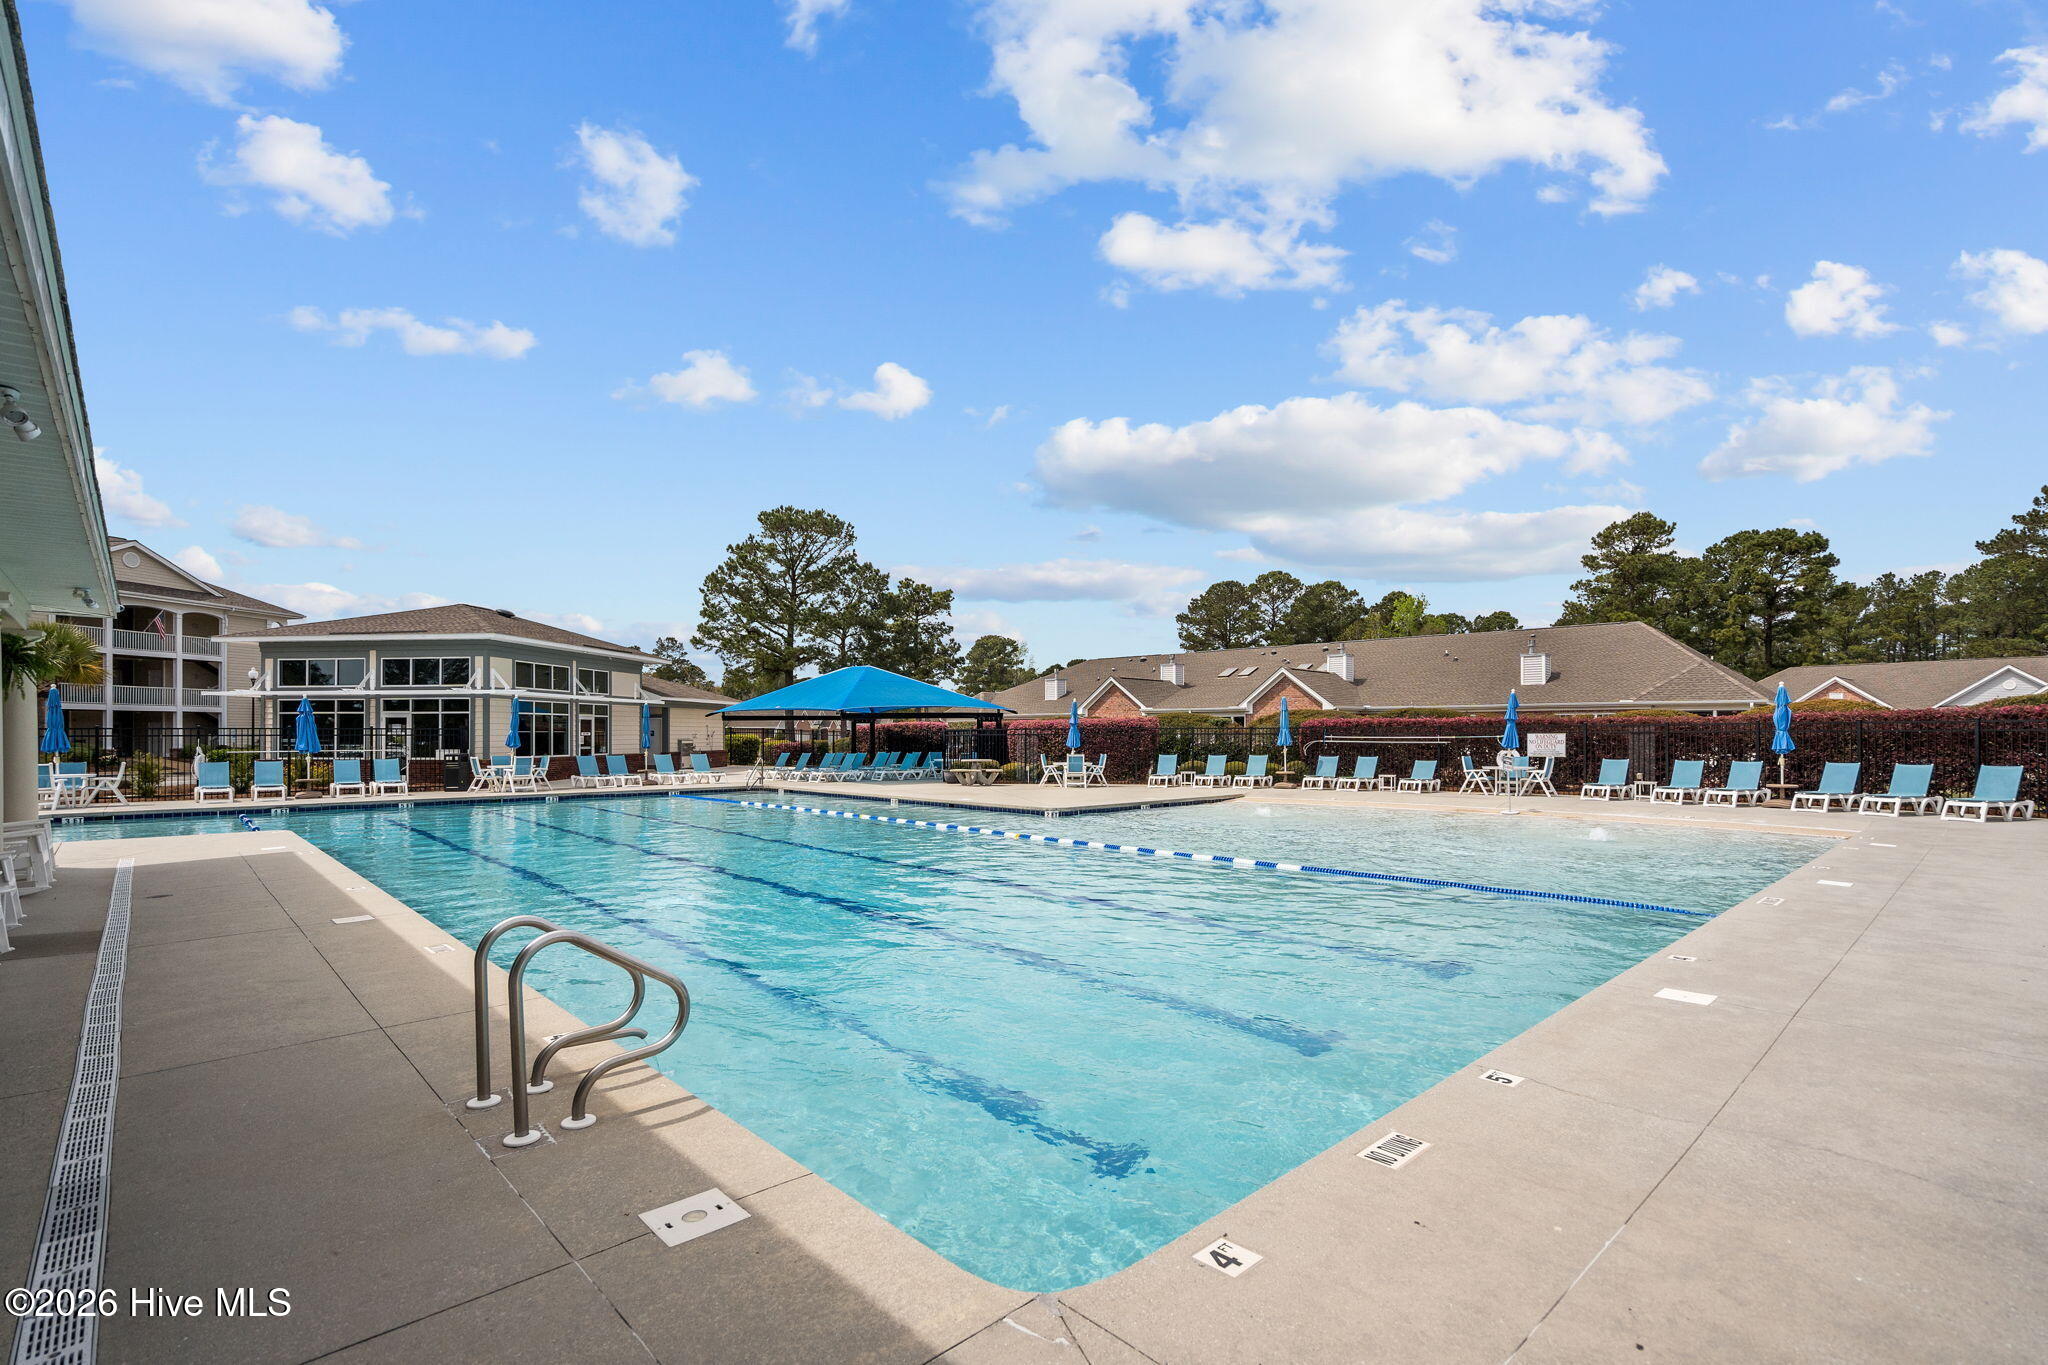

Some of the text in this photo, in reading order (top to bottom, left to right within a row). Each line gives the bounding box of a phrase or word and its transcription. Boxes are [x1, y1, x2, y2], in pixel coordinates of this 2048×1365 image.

[1485, 1074, 1513, 1084] 5
[1363, 1134, 1424, 1167] NO DIVING
[1209, 1242, 1244, 1269] 4 FT
